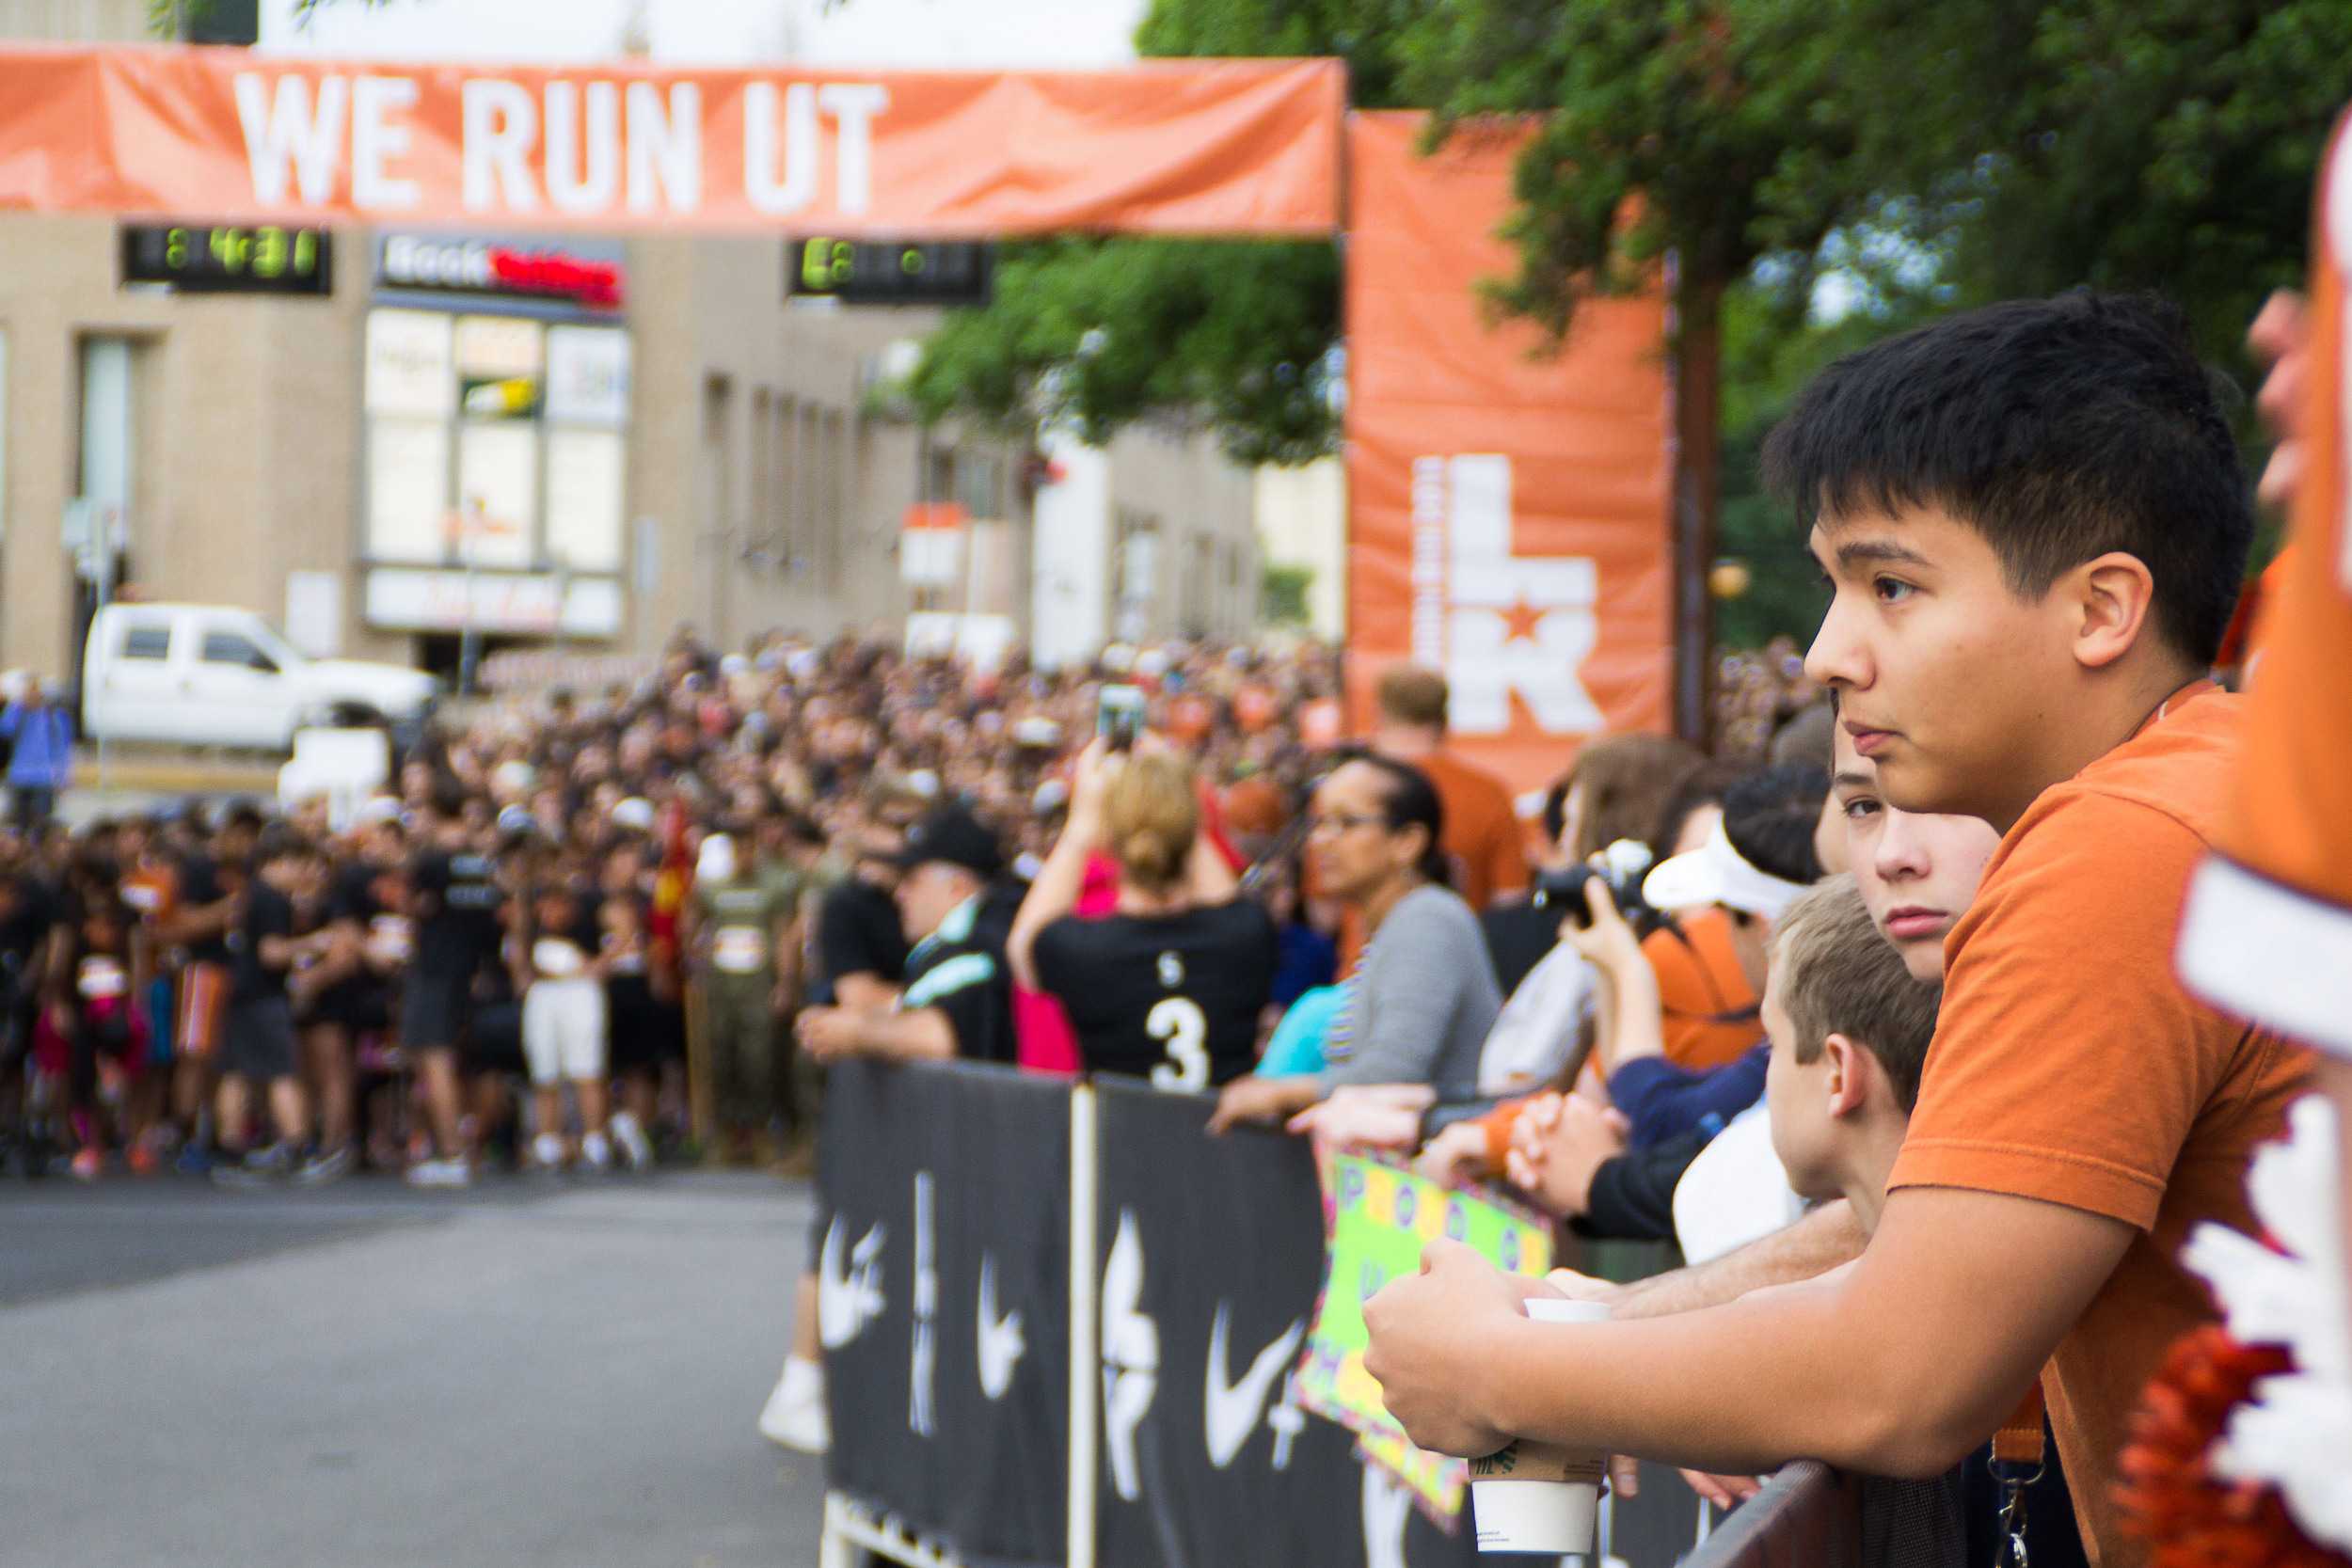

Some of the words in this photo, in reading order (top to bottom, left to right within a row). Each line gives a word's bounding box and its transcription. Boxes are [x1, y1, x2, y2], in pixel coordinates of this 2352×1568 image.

[235, 71, 421, 210] WE
[462, 77, 701, 216] RUN
[743, 81, 890, 217] UT
[1146, 995, 1211, 1094] 3
